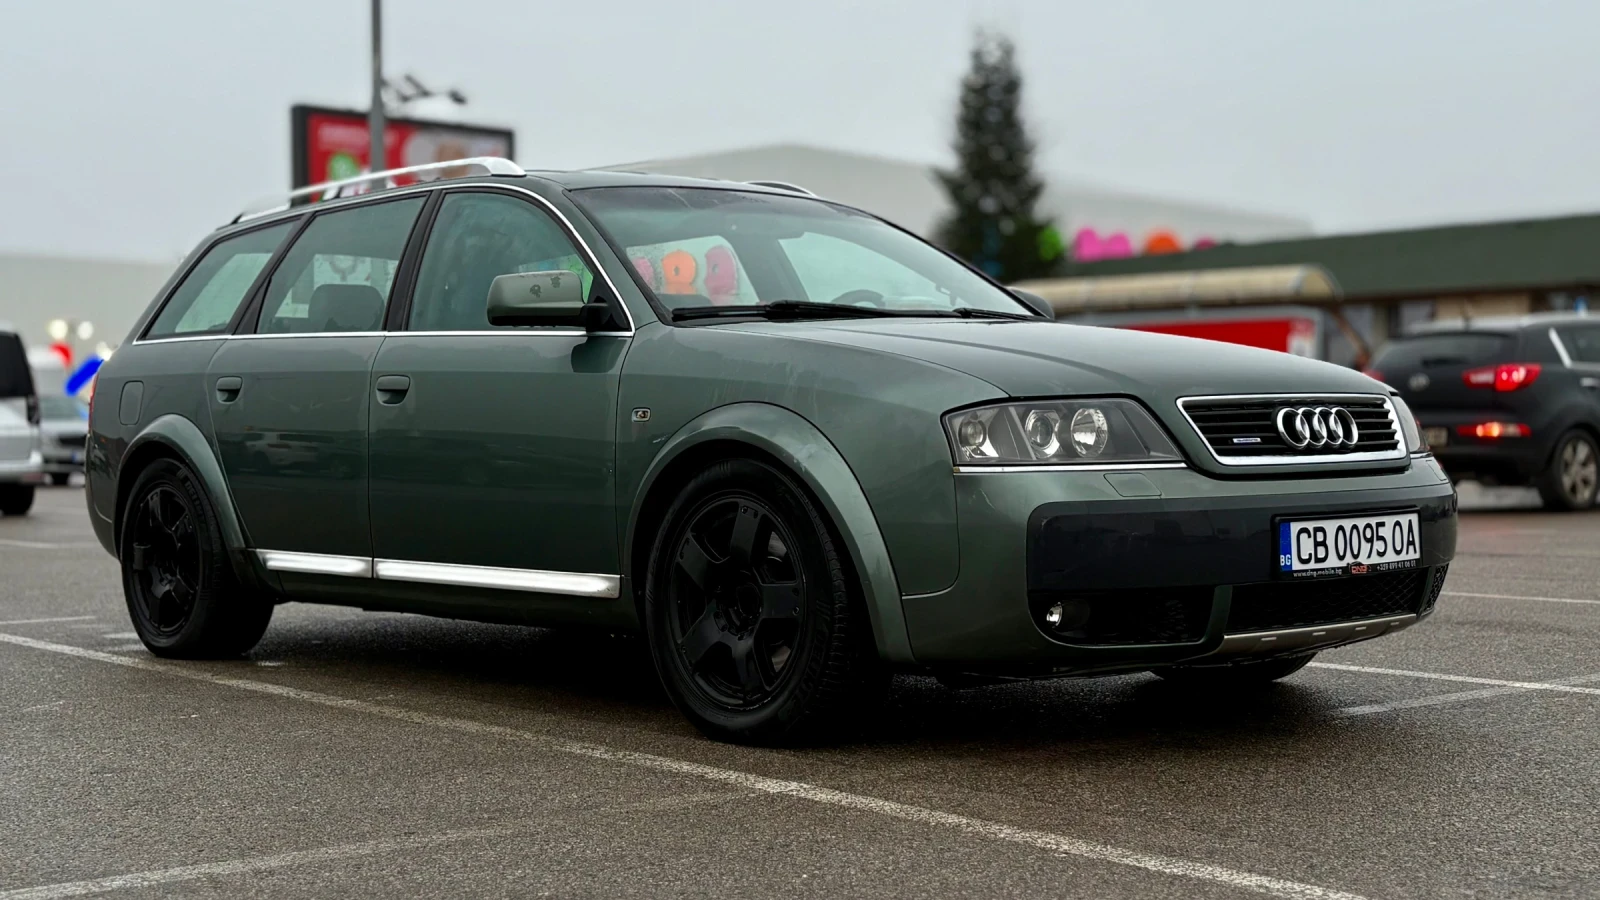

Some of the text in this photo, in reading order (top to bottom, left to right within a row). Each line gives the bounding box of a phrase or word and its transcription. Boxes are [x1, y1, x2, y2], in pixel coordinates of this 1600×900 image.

[1296, 526, 1329, 565] CB
[1334, 521, 1388, 562] 0095
[1280, 554, 1291, 566] BG
